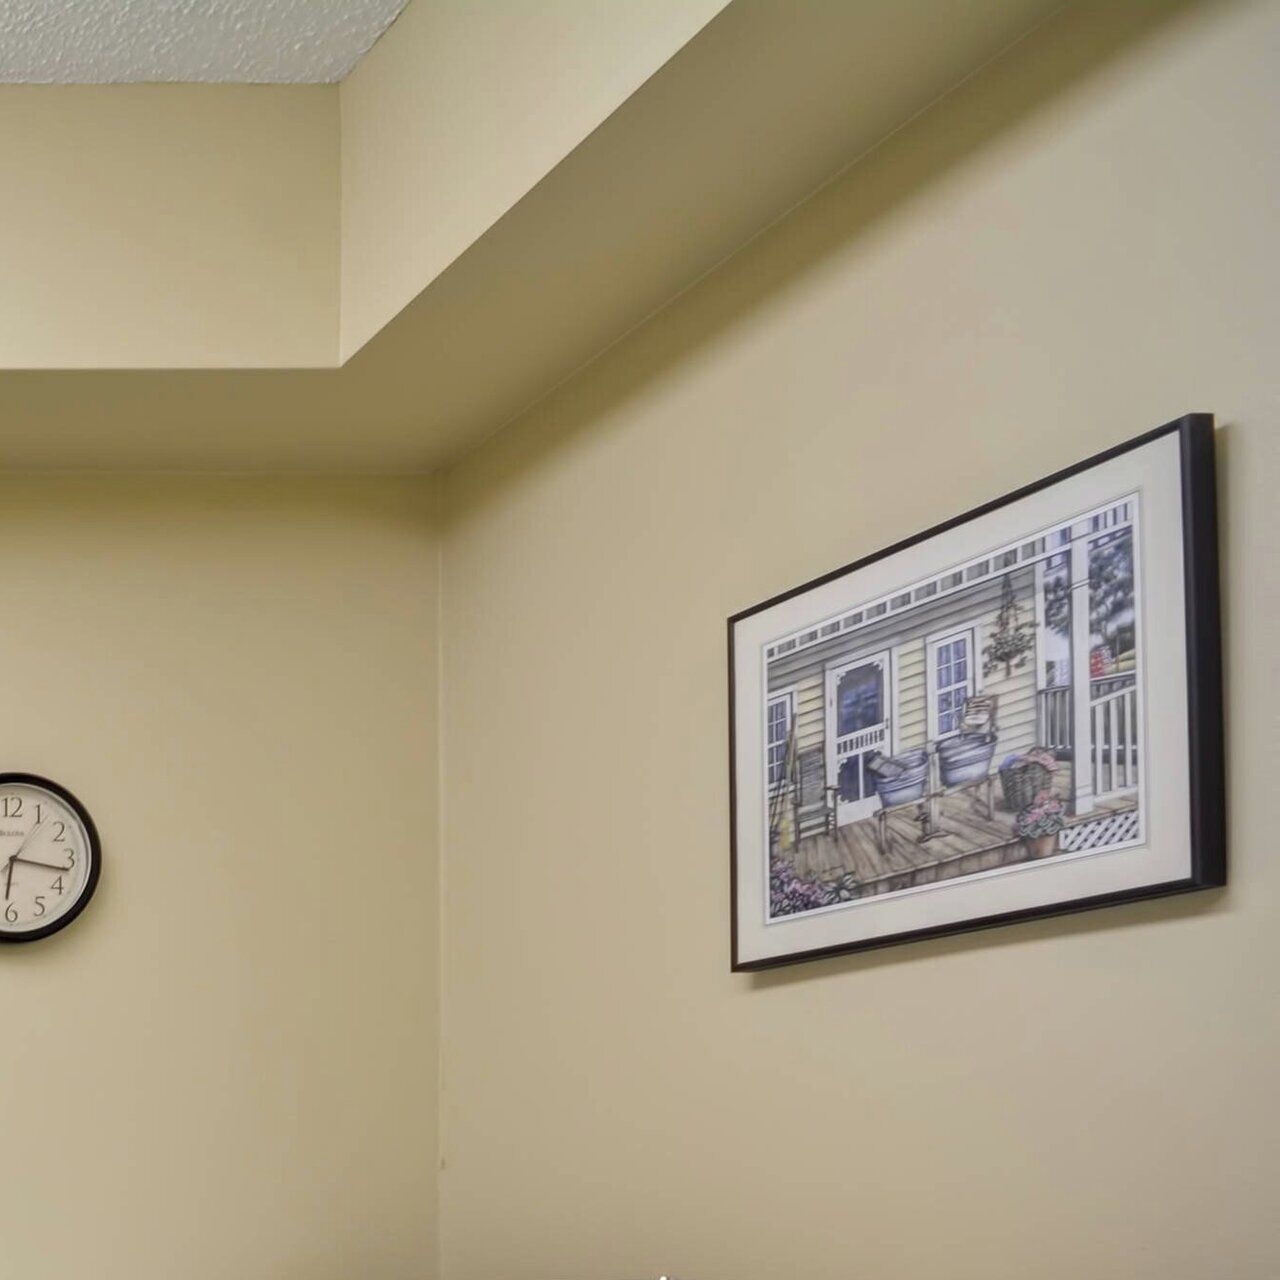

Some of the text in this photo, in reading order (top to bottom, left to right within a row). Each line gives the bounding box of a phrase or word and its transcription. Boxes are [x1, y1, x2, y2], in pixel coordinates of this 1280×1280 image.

[2, 797, 23, 818] 12
[34, 804, 42, 825] 1
[52, 821, 65, 842] 2
[64, 848, 76, 869] 3
[50, 875, 65, 896] 4
[4, 901, 19, 923] 6
[33, 896, 46, 917] 5
